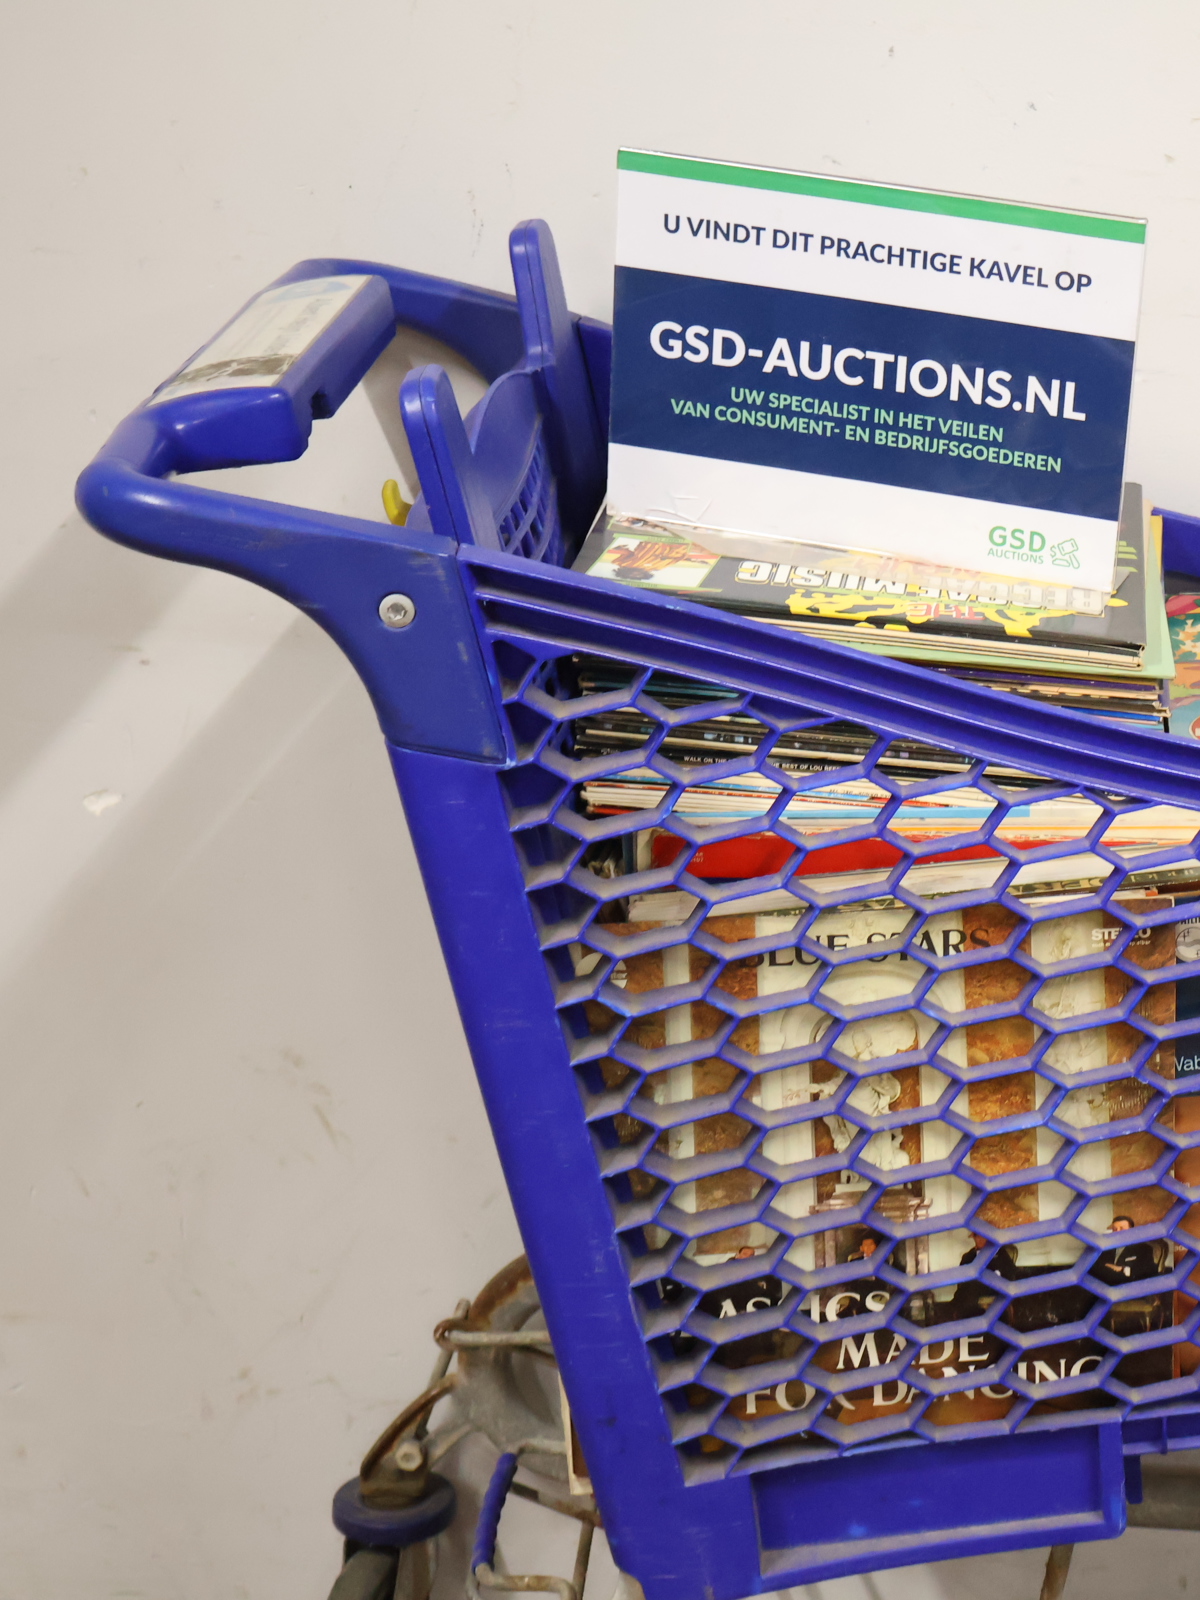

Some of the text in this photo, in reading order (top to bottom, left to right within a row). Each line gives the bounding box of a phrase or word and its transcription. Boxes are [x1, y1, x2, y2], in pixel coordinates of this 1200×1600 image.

[663, 213, 1093, 293] U VINDT DIT PRACHTIGE KAVEL OP
[648, 320, 1087, 422] GSD-AUCTIONS.NL
[730, 386, 1004, 443] UW SPECIALIST IN HET VEILEN
[670, 398, 1062, 474] VAN CONSUMENT- EN BEDRIJFSGOEDEREN
[987, 547, 1044, 565] AUCTIONS
[988, 525, 1047, 553] GSD
[735, 560, 909, 597] MUSIC
[683, 755, 702, 764] WALK
[799, 763, 809, 771] OF
[1091, 927, 1152, 941] STEO
[836, 1332, 990, 1370] MADE
